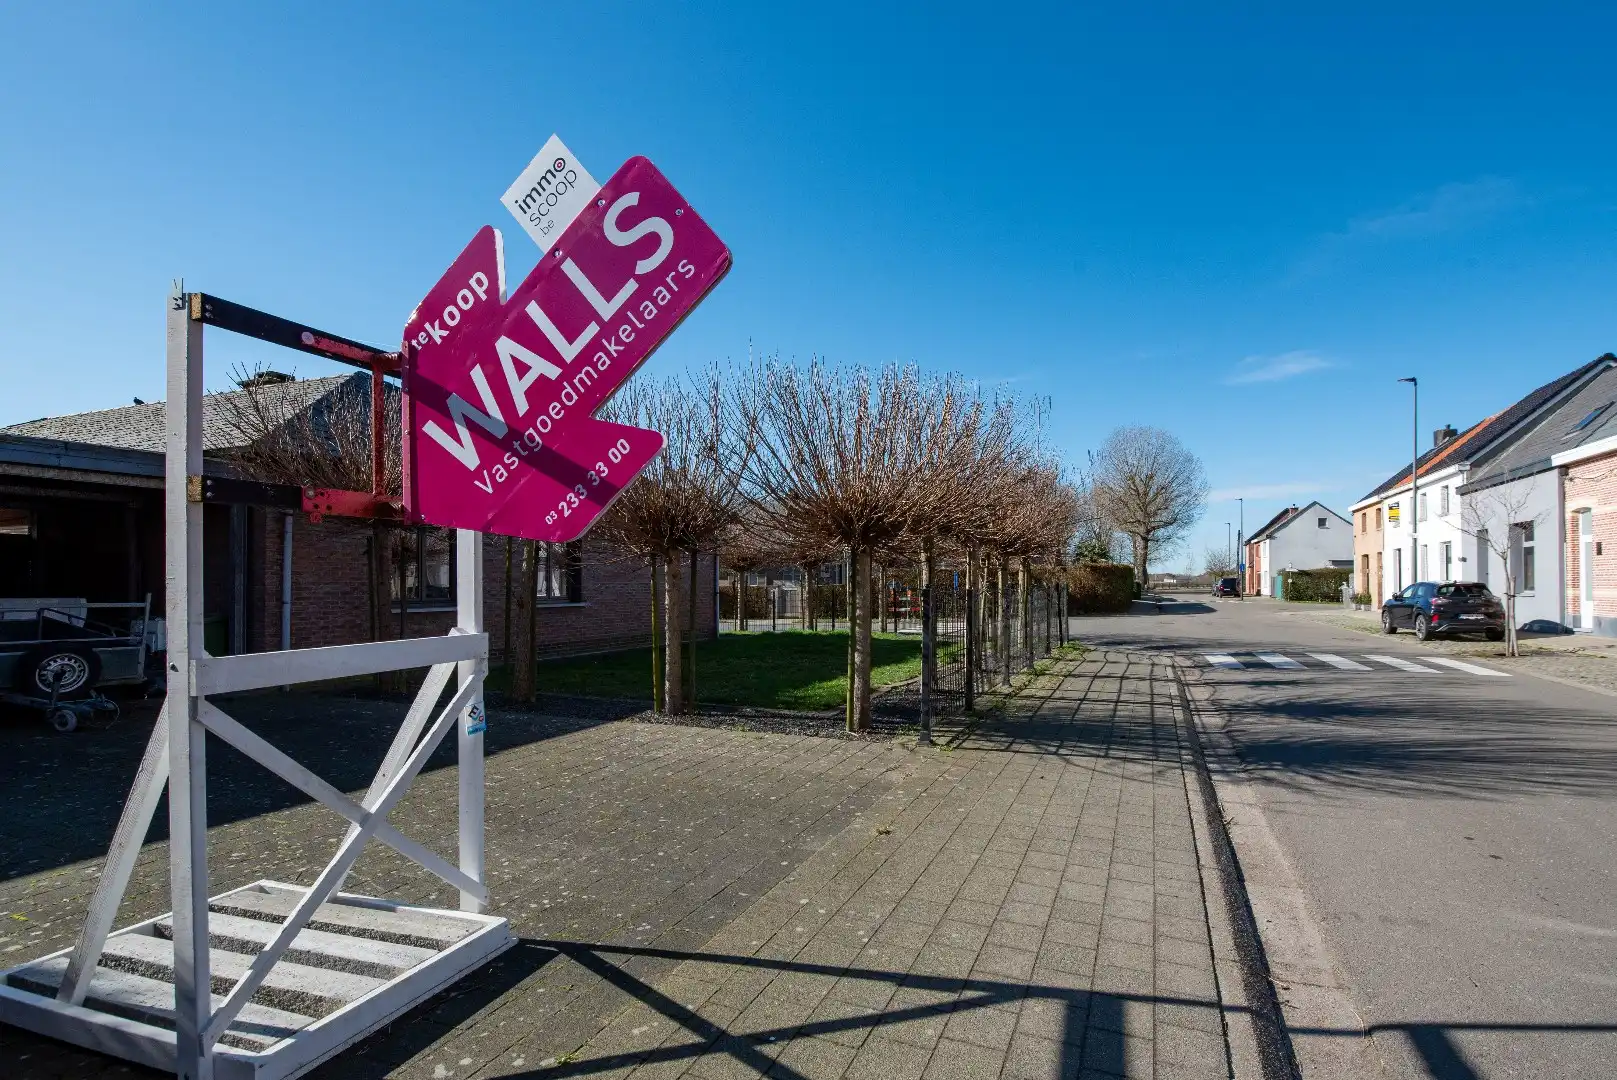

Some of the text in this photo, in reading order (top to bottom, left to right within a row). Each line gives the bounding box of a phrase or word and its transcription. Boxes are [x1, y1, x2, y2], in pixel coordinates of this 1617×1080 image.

[514, 157, 566, 215] immo
[529, 169, 577, 227] scoop
[421, 191, 675, 473] WALLS
[544, 438, 631, 525] 03 233 33 00
